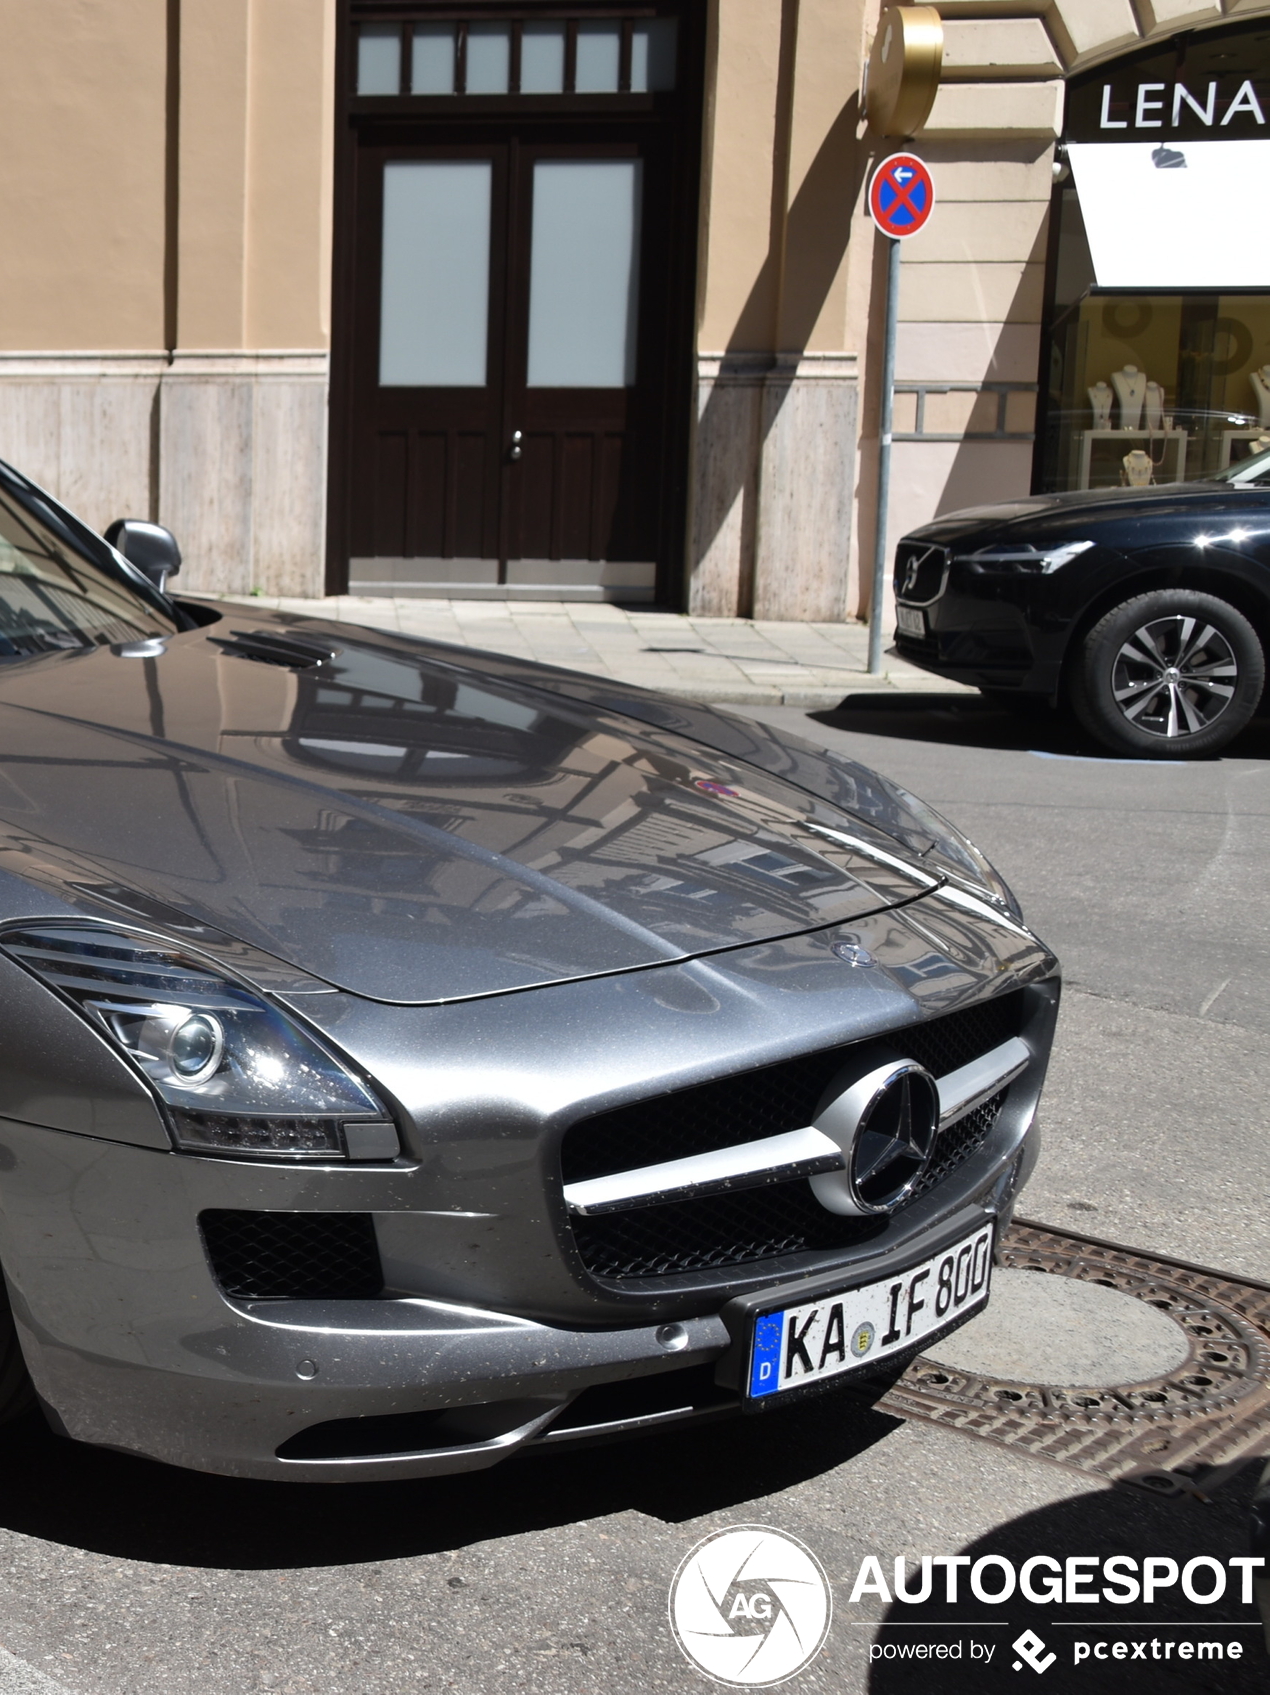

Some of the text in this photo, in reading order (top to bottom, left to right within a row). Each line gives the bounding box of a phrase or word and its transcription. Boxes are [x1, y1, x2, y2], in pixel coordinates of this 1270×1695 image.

[1100, 80, 1266, 128] LENA
[784, 1232, 989, 1380] KA IF 800
[759, 1361, 772, 1381] D
